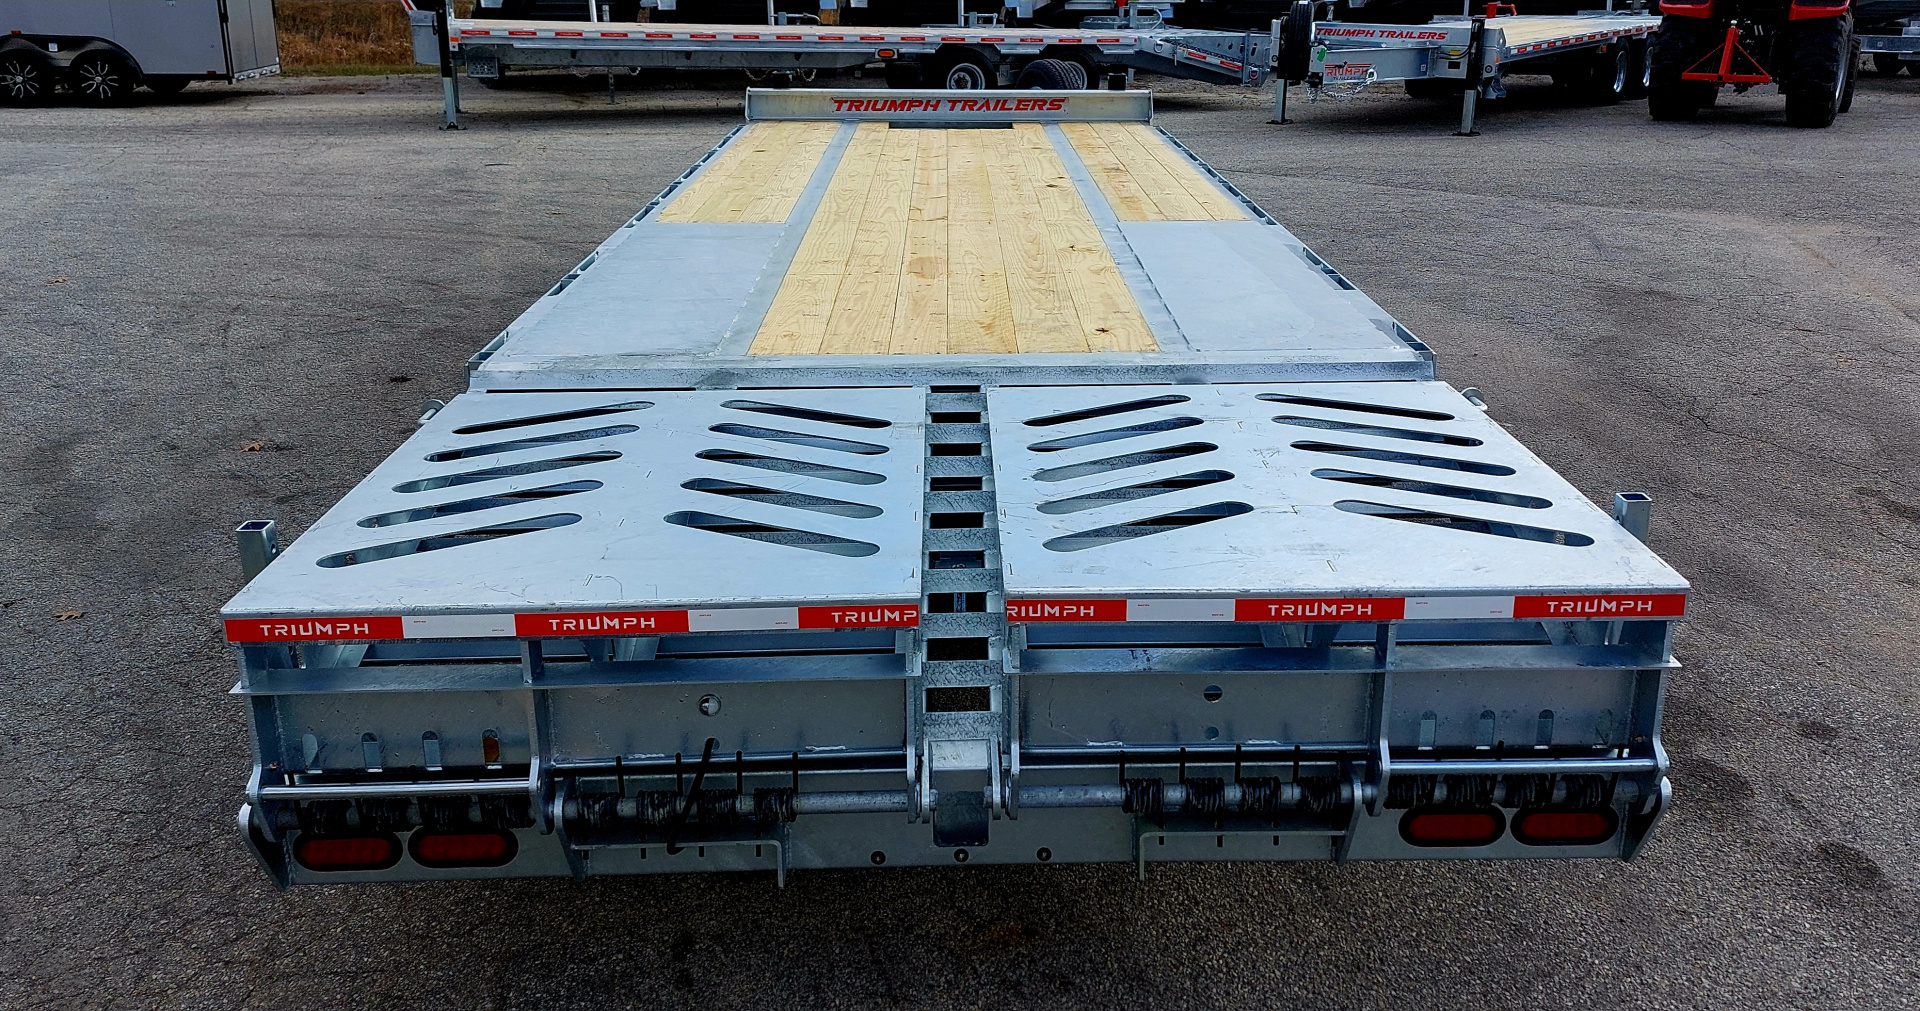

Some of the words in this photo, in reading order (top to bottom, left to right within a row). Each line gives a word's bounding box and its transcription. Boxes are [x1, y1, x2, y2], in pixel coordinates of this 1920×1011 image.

[1316, 27, 1376, 38] TRIUMPH
[1379, 30, 1448, 40] TRAILERS
[833, 99, 940, 112] TRIUMPH
[947, 98, 1066, 112] TRAILERS
[1267, 602, 1373, 616] TRIUMPH
[1546, 599, 1653, 613] TRIUMPH
[259, 621, 370, 637] TRIUMPH
[548, 614, 656, 632] TRIUMPH
